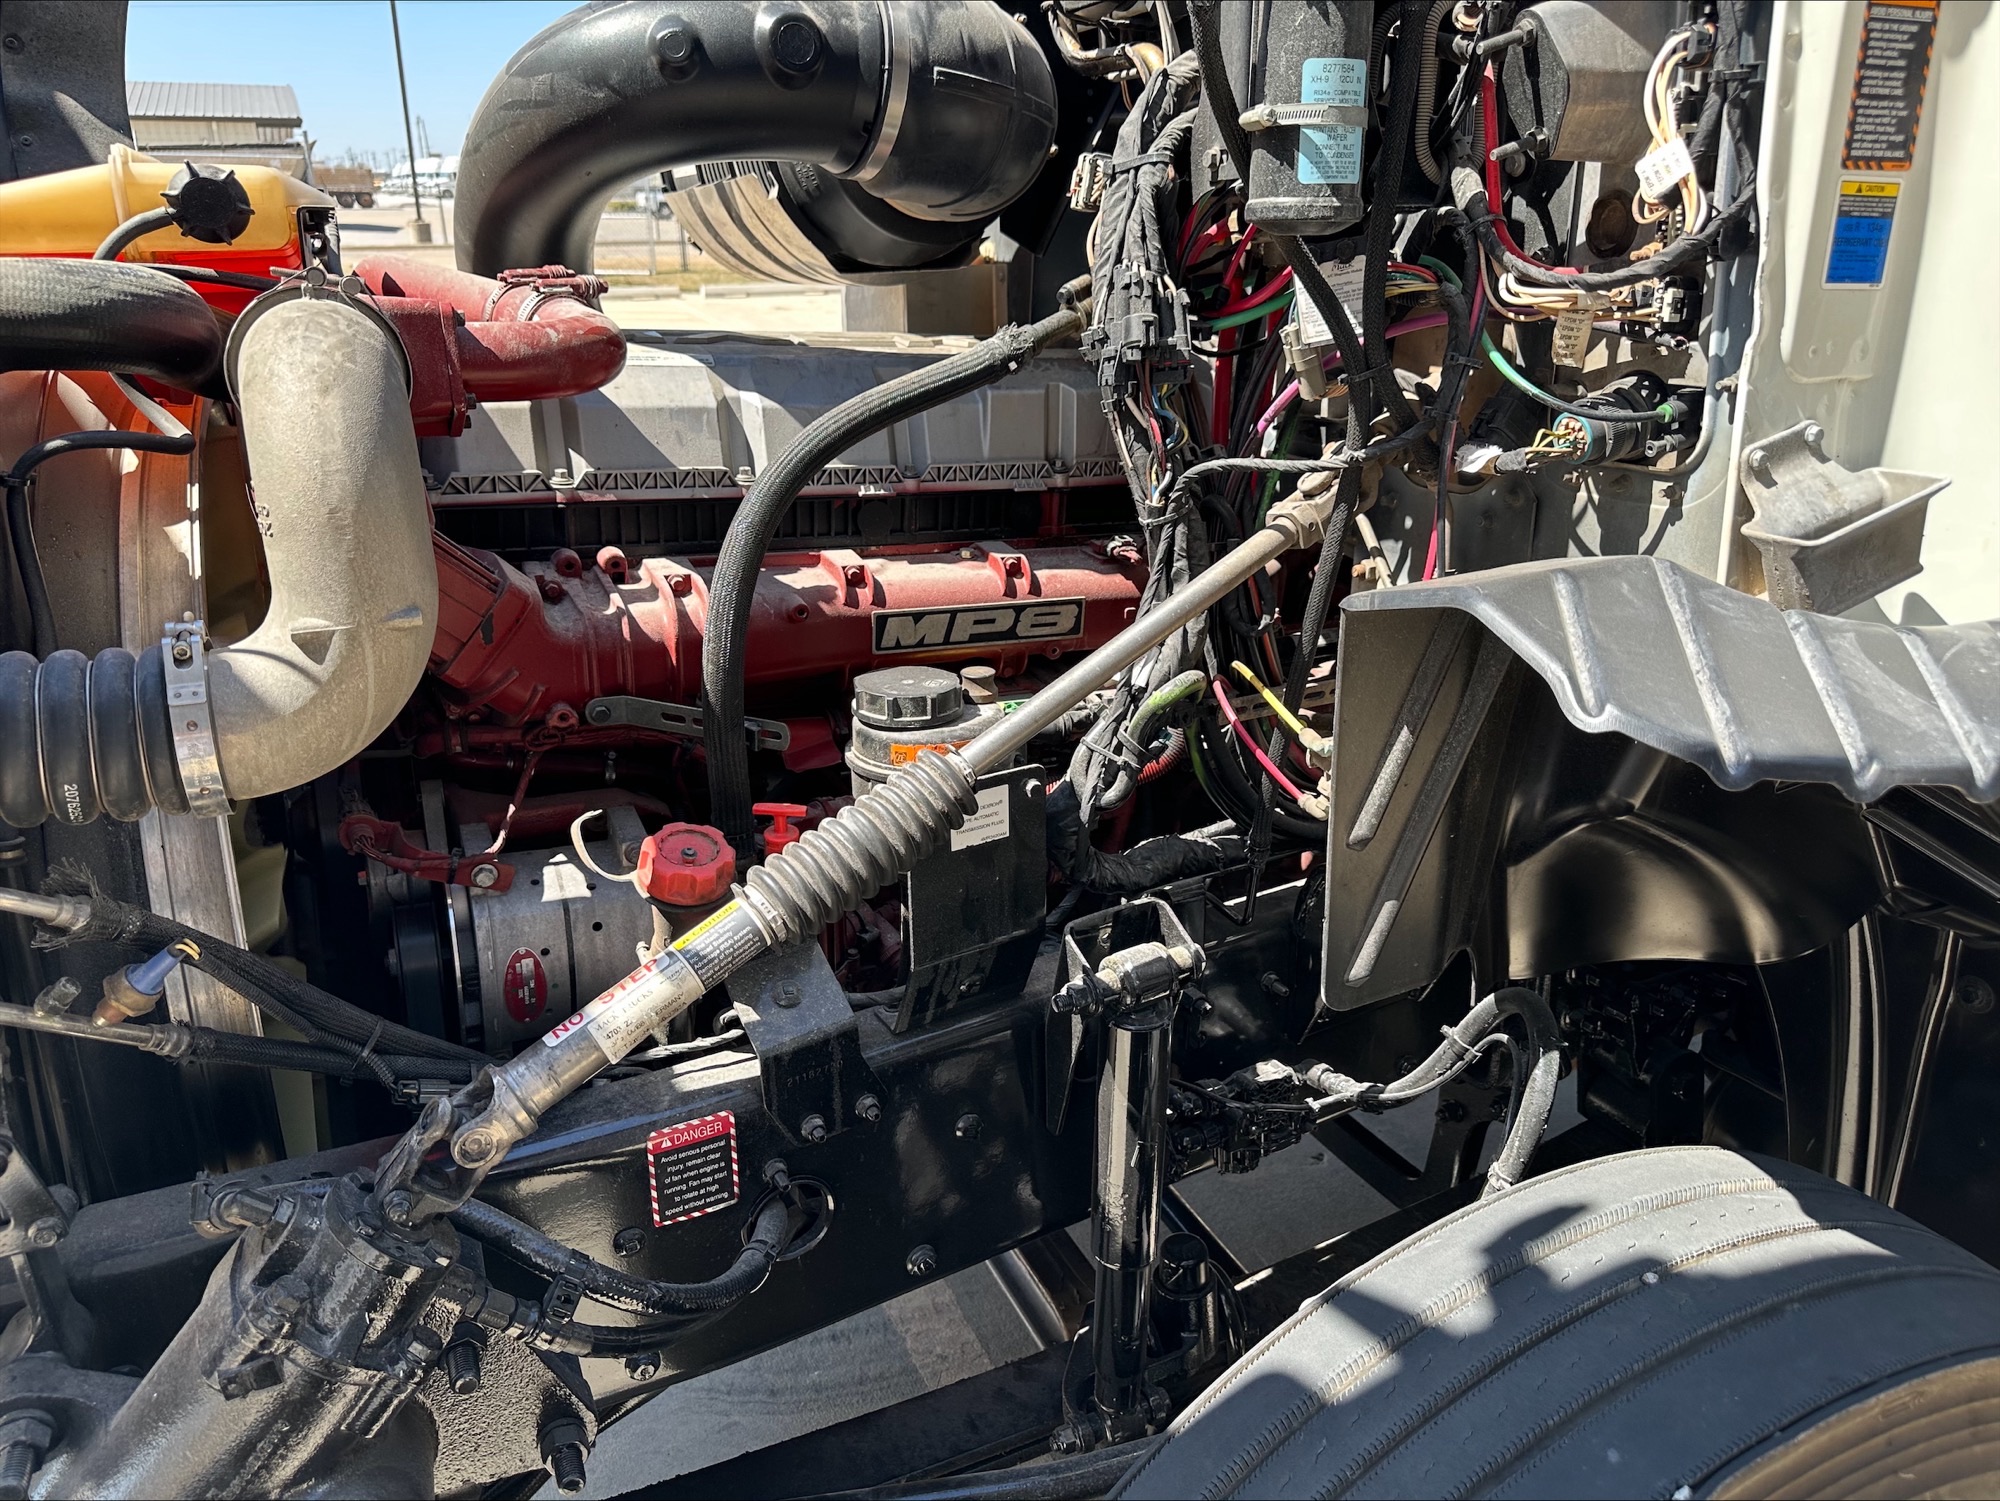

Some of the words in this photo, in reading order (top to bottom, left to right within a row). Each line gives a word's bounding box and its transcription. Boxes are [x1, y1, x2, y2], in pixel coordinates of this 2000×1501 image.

[1865, 184, 1886, 193] CAUTION
[880, 604, 1079, 649] MP8
[973, 811, 1000, 822] AUTOMATIC
[956, 823, 991, 836] TRANSMISSION
[991, 819, 1005, 827] FLUID
[692, 905, 732, 936] CAUTION
[693, 947, 720, 970] Advantage
[719, 937, 734, 951] (RSA)
[697, 957, 719, 975] Removal
[718, 952, 726, 960] of
[724, 946, 733, 955] the
[732, 932, 753, 949] steering
[699, 944, 713, 956] Road
[551, 1012, 584, 1039] NO
[598, 958, 659, 1004] STEP
[674, 1121, 723, 1145] DANGER
[661, 1153, 678, 1164] Avoid
[678, 1148, 700, 1159] serious
[701, 1139, 726, 1153] personal
[685, 1156, 706, 1167] remain
[706, 1152, 722, 1161] clear
[664, 1176, 671, 1184] of
[672, 1174, 682, 1182] fan
[682, 1169, 699, 1178] when
[699, 1163, 719, 1173] engine
[688, 1179, 701, 1187] Fan
[701, 1175, 714, 1183] may
[714, 1170, 728, 1180] start
[682, 1190, 699, 1200] rotate
[699, 1187, 706, 1195] at
[706, 1183, 720, 1192] high
[664, 1205, 683, 1216] speed
[684, 1198, 705, 1210] without
